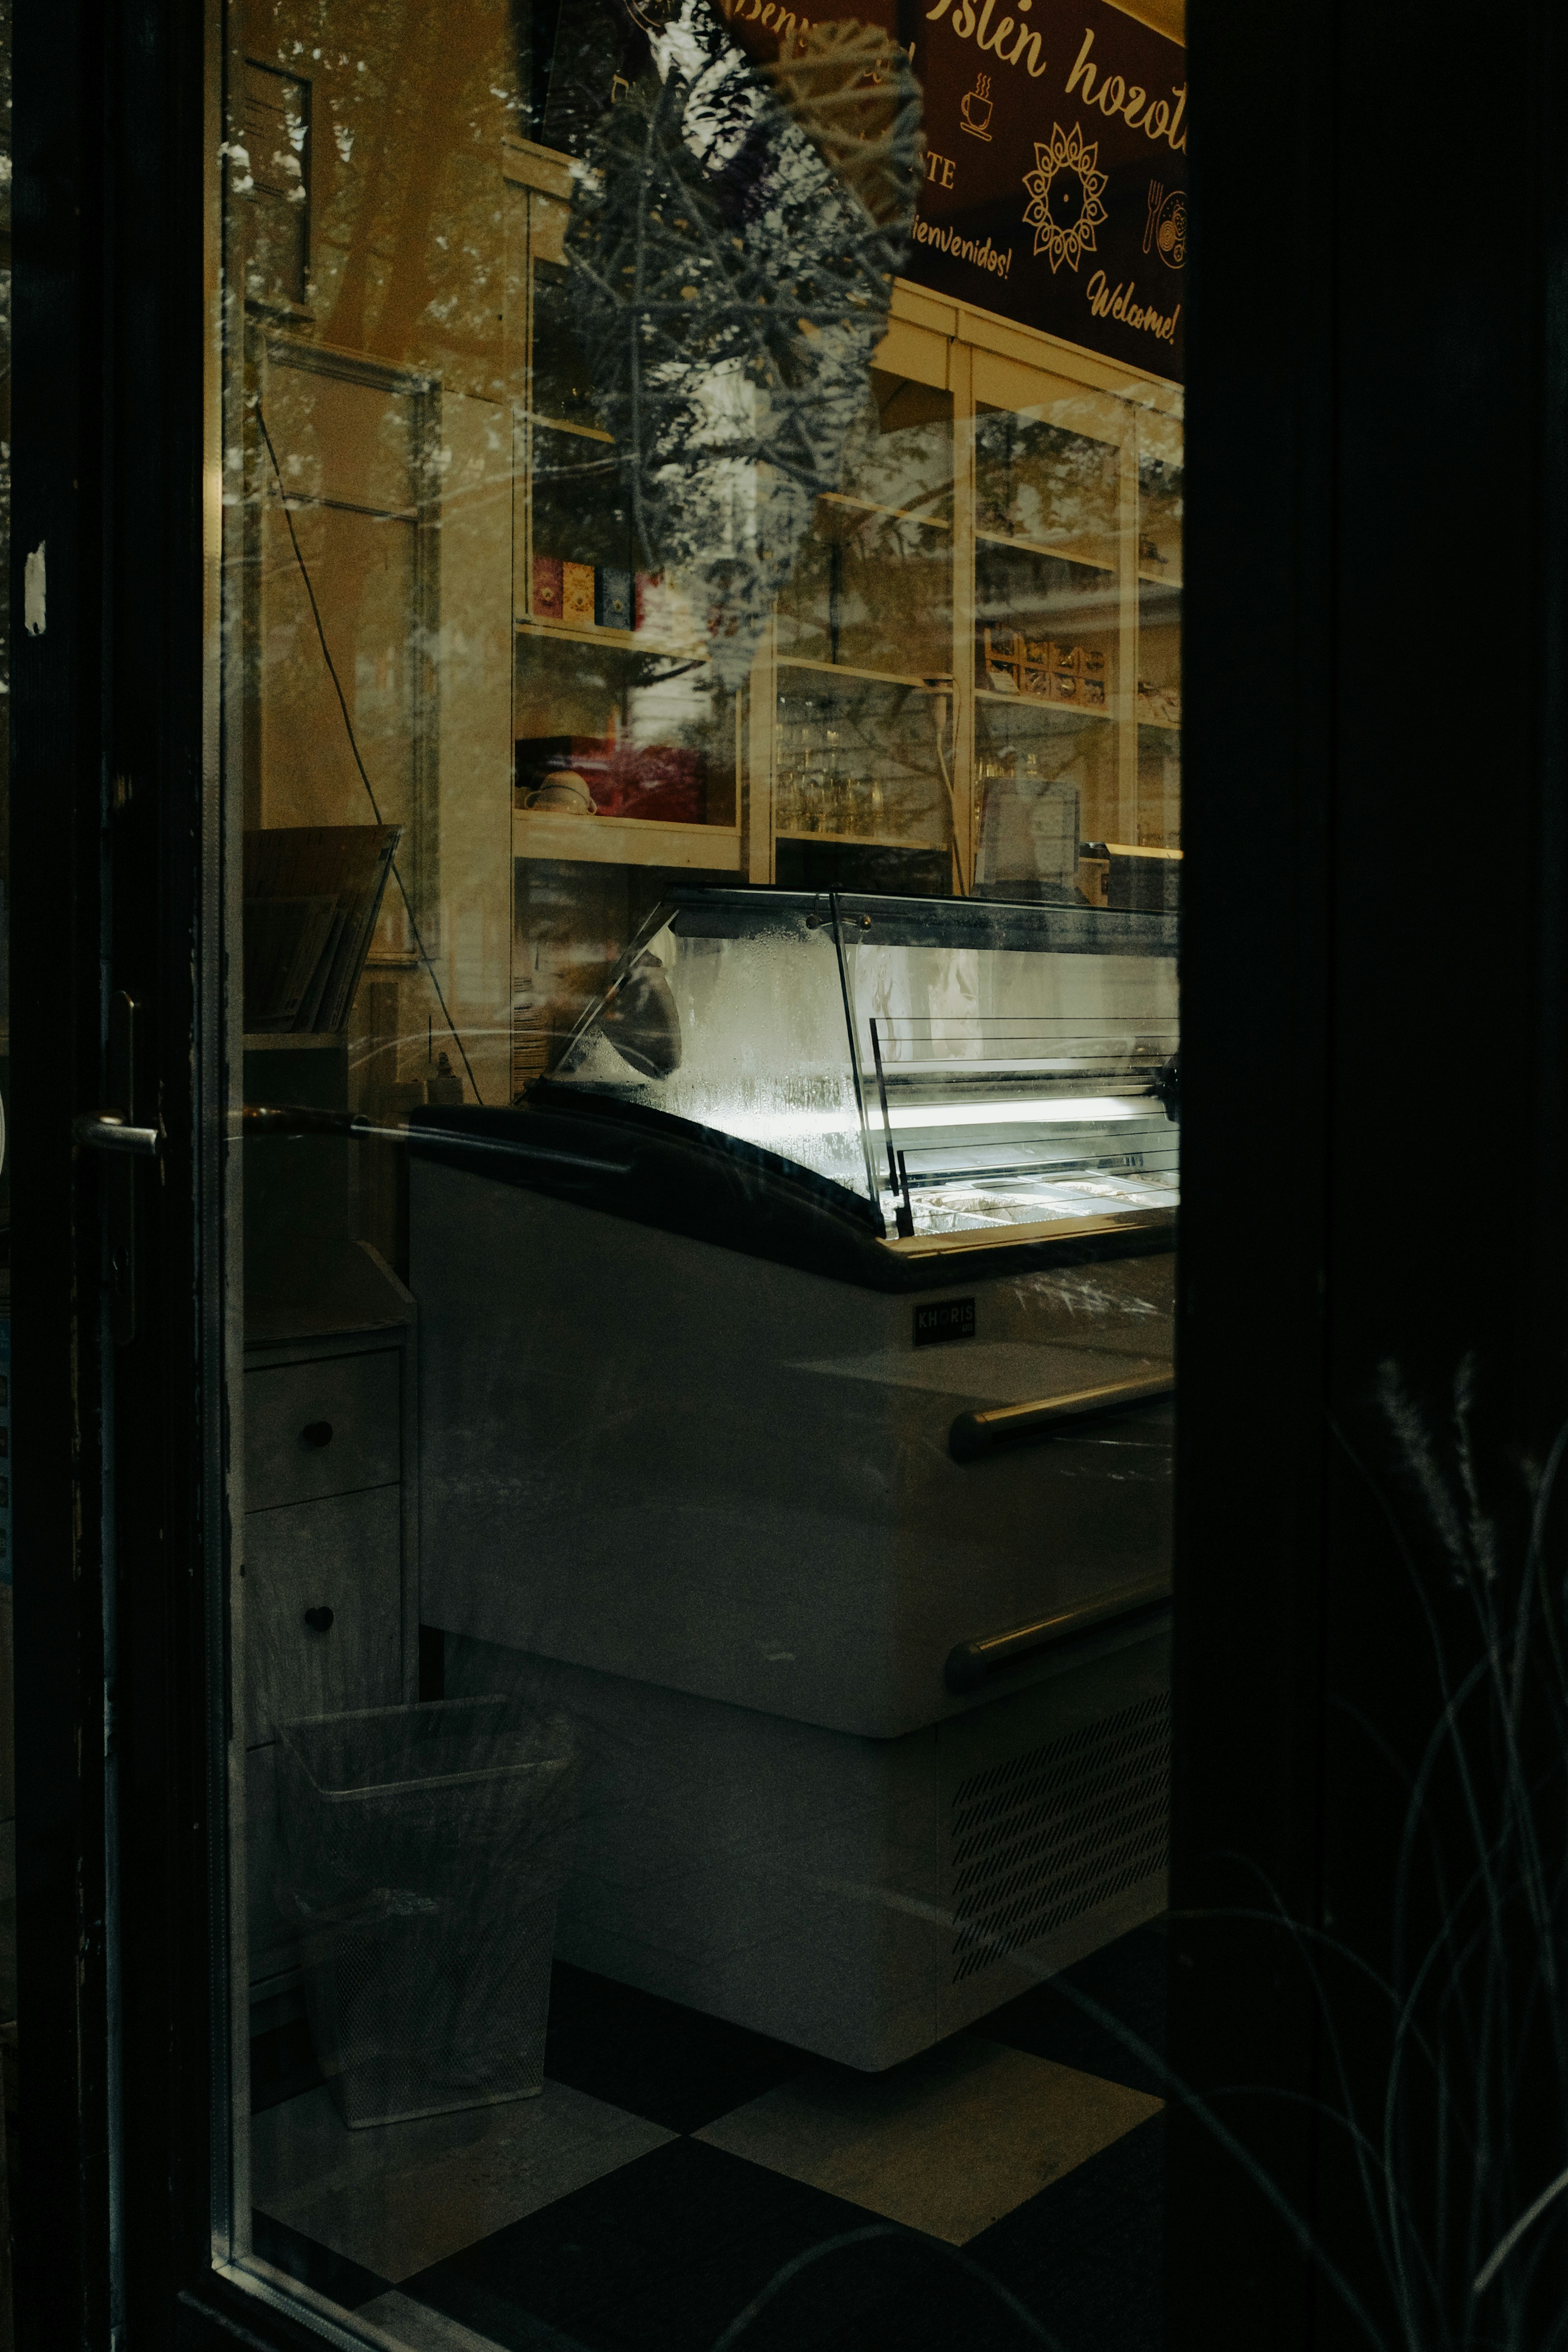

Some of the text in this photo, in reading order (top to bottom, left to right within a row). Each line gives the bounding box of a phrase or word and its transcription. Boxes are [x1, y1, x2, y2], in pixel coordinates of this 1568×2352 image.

[1064, 28, 1189, 156] hozot
[912, 214, 1013, 280] ienvenidos!
[1086, 269, 1181, 345] Welcome!
[918, 1304, 973, 1328] KHORIS
